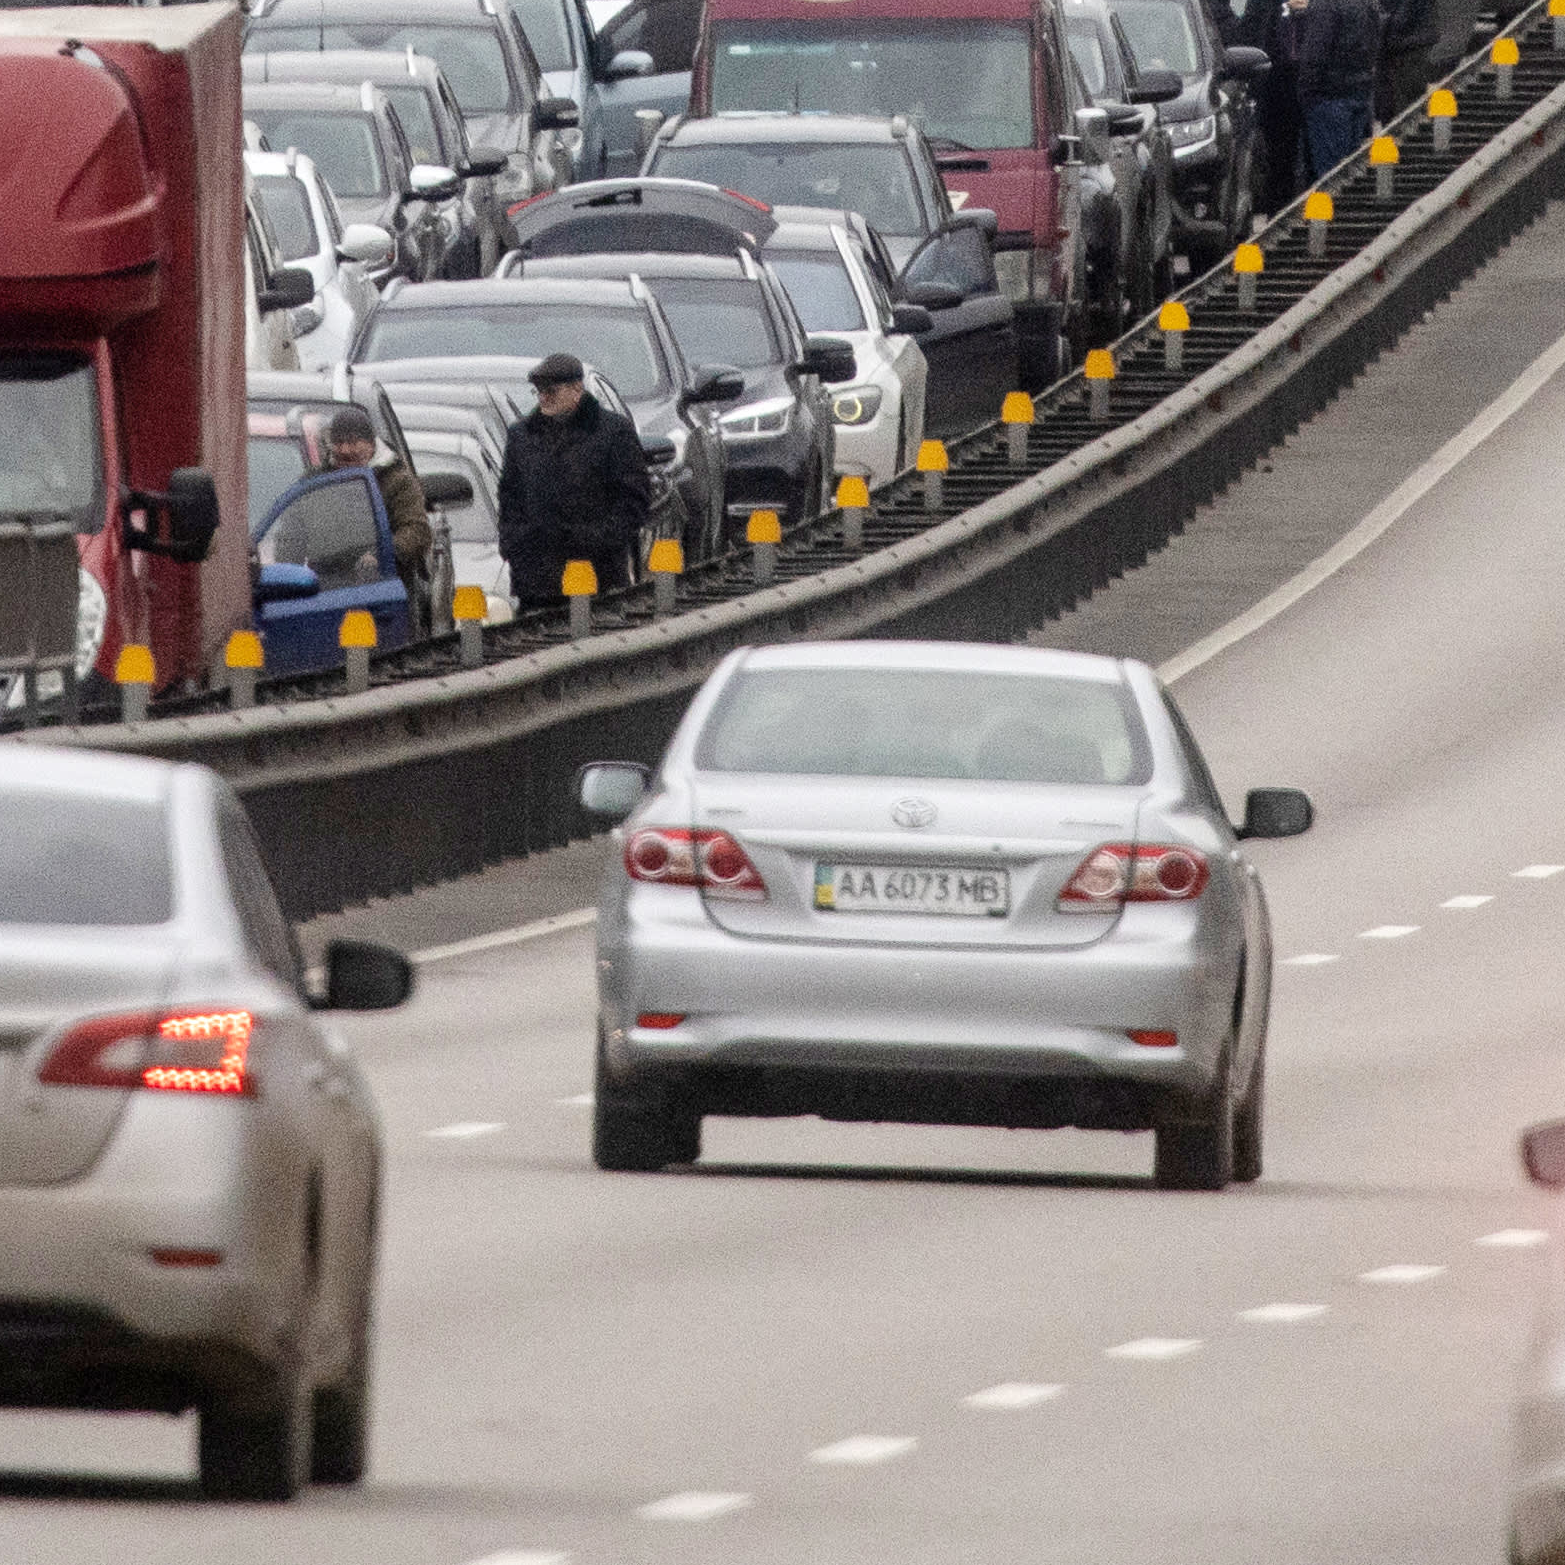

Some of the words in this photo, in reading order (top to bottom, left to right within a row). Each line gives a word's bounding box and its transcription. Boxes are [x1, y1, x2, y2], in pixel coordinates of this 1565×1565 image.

[839, 870, 879, 899] AA
[884, 870, 950, 902] 6073
[957, 873, 1000, 904] MB
